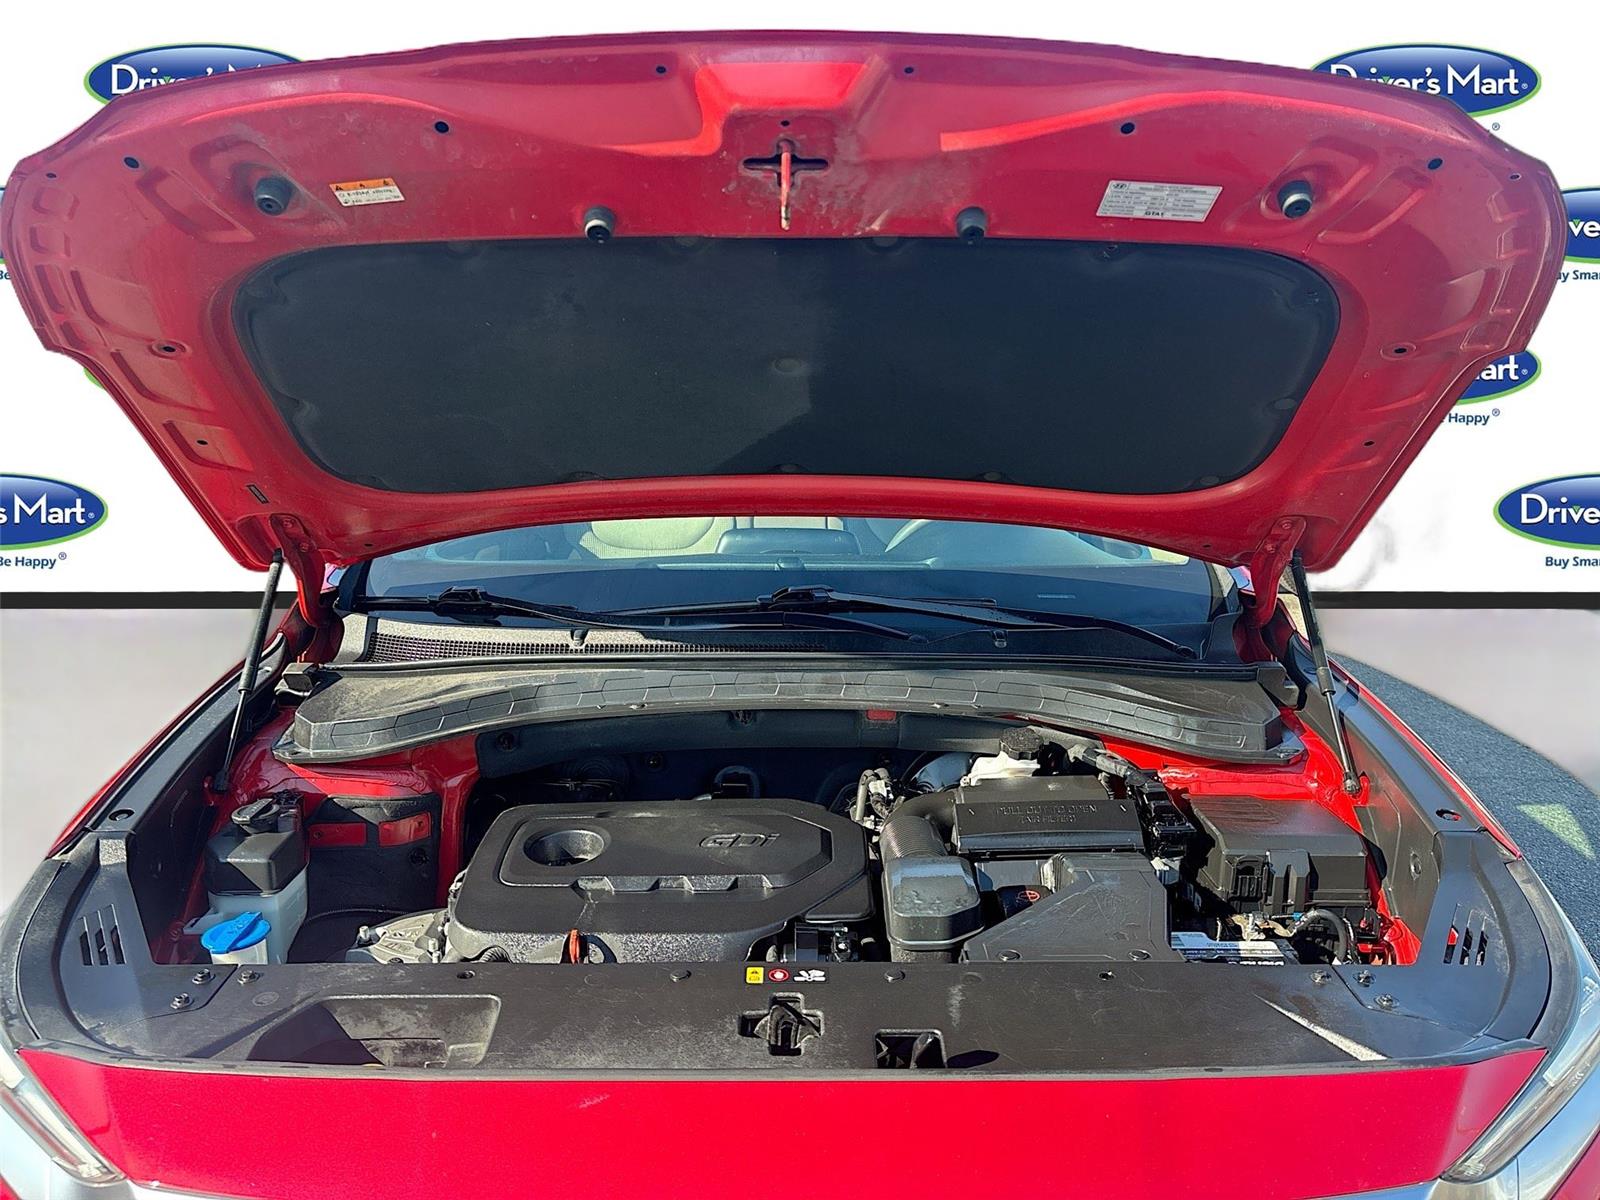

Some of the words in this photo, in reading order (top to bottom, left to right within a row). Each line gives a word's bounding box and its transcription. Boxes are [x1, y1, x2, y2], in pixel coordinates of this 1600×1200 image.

[1447, 64, 1519, 95] Mart
[1476, 355, 1520, 380] art
[1448, 413, 1490, 426] Happy
[14, 493, 86, 524] Mart
[15, 556, 57, 570] Happy
[1545, 556, 1570, 570] Buy
[999, 805, 1023, 815] PULL
[699, 832, 780, 848] GDi
